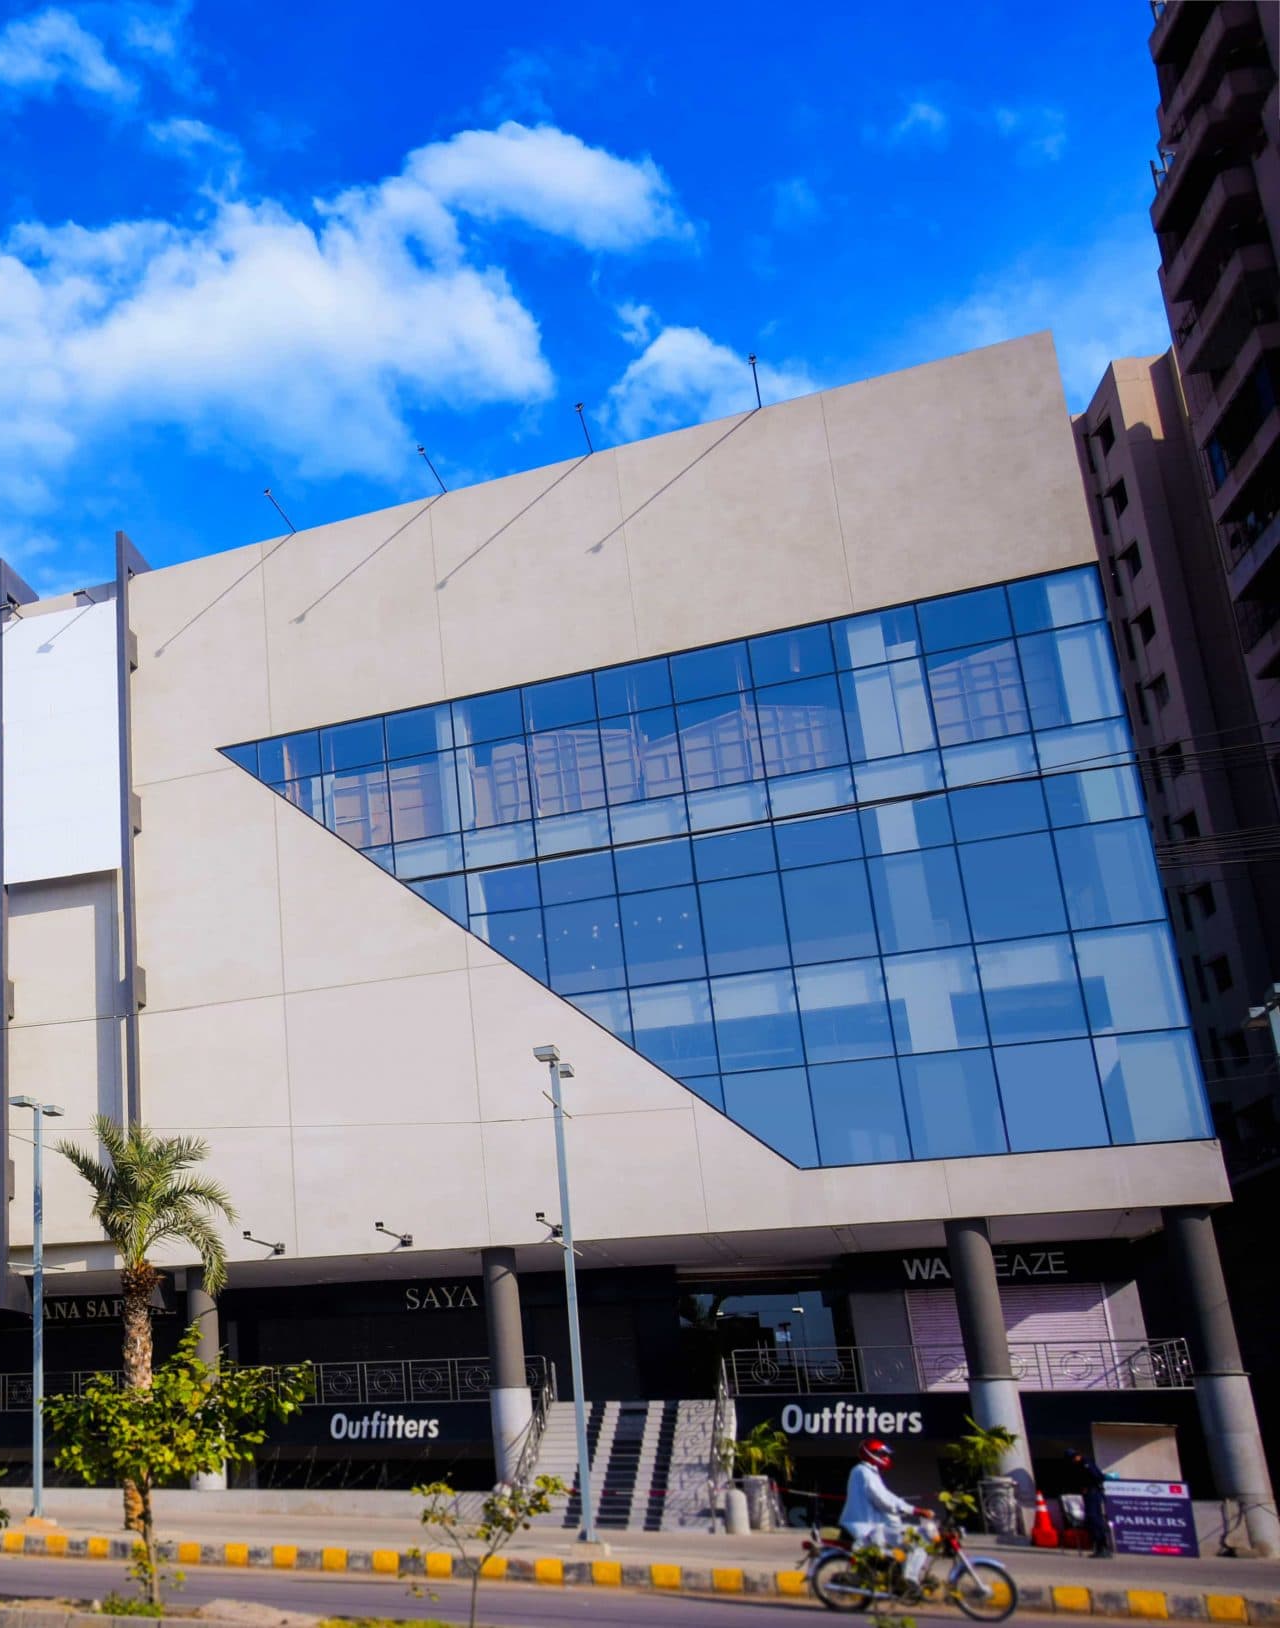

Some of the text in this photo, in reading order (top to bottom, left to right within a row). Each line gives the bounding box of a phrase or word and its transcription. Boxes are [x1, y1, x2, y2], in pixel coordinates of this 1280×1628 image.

[30, 1301, 81, 1320] ANA
[405, 1285, 479, 1311] SAYA
[330, 1410, 439, 1439] Outfitters
[781, 1401, 923, 1434] Outfitters
[1115, 1515, 1186, 1528] PARKERS
